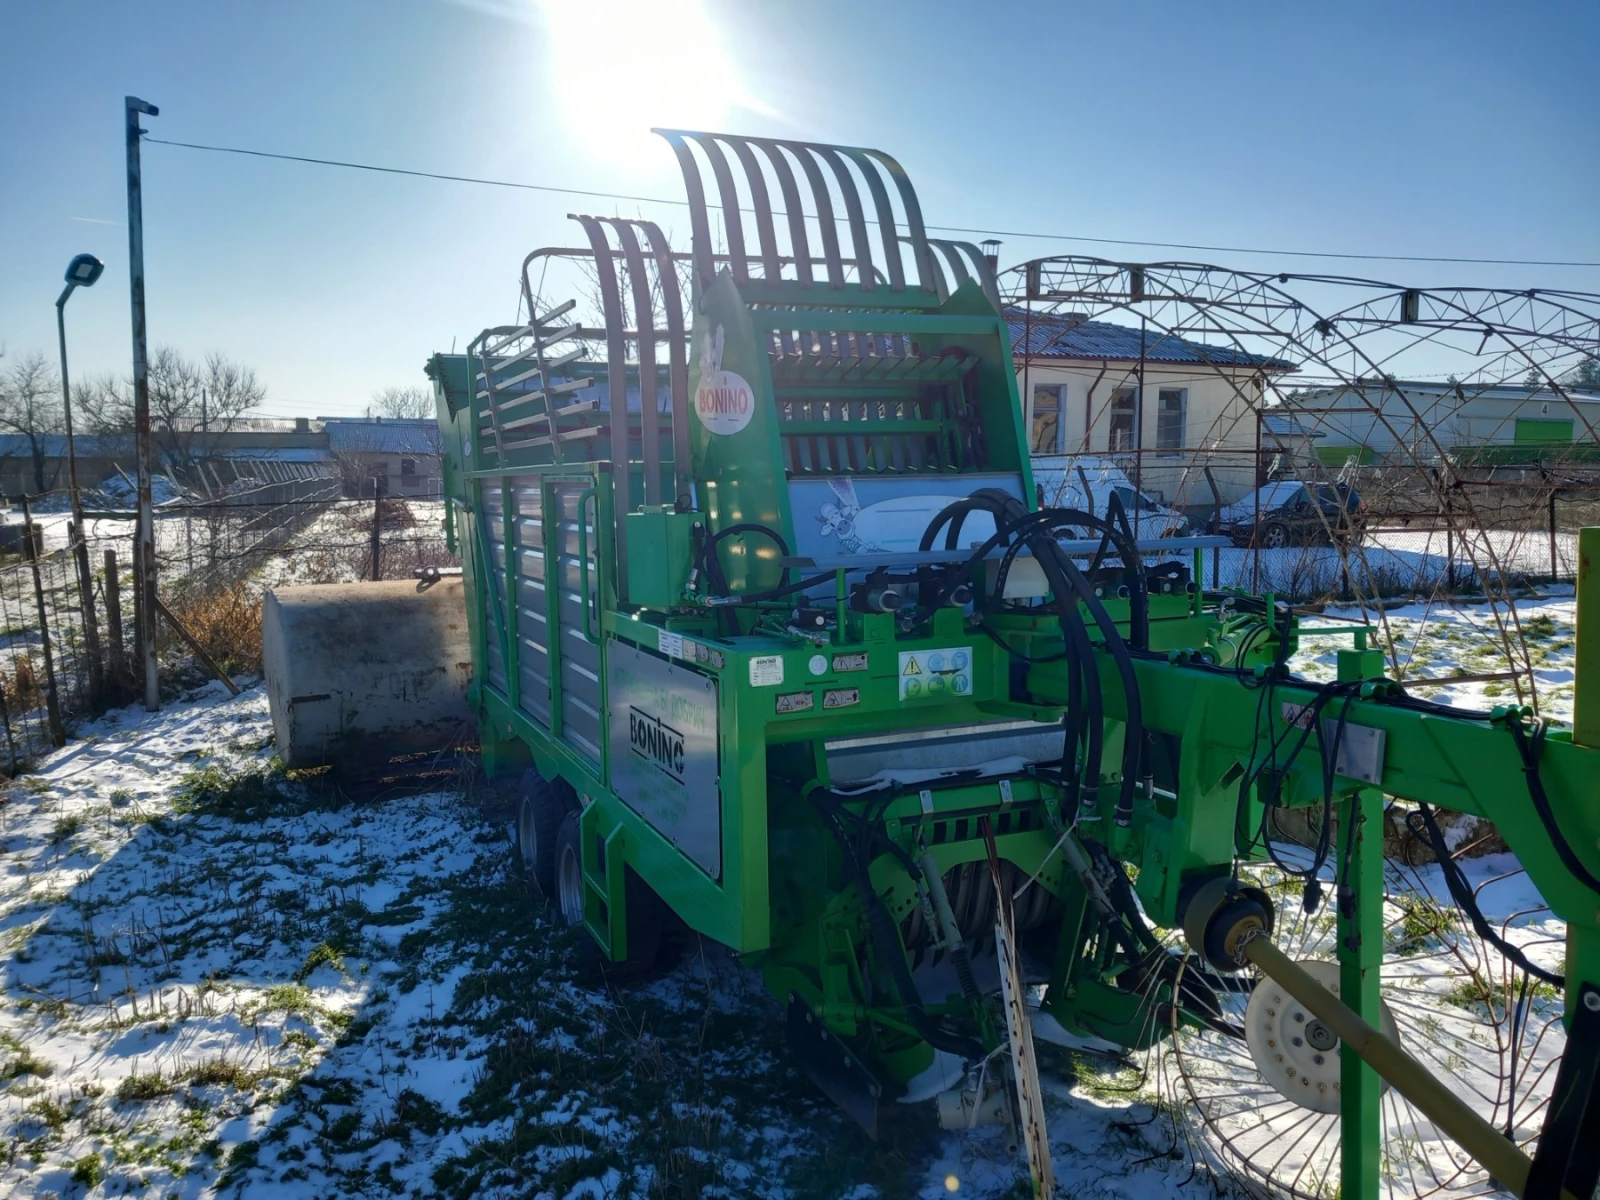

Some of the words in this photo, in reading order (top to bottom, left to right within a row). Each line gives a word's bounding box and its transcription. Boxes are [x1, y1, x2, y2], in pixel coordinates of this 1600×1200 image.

[699, 387, 748, 415] BONINO
[1542, 404, 1548, 415] 4
[630, 713, 684, 775] BONINO
